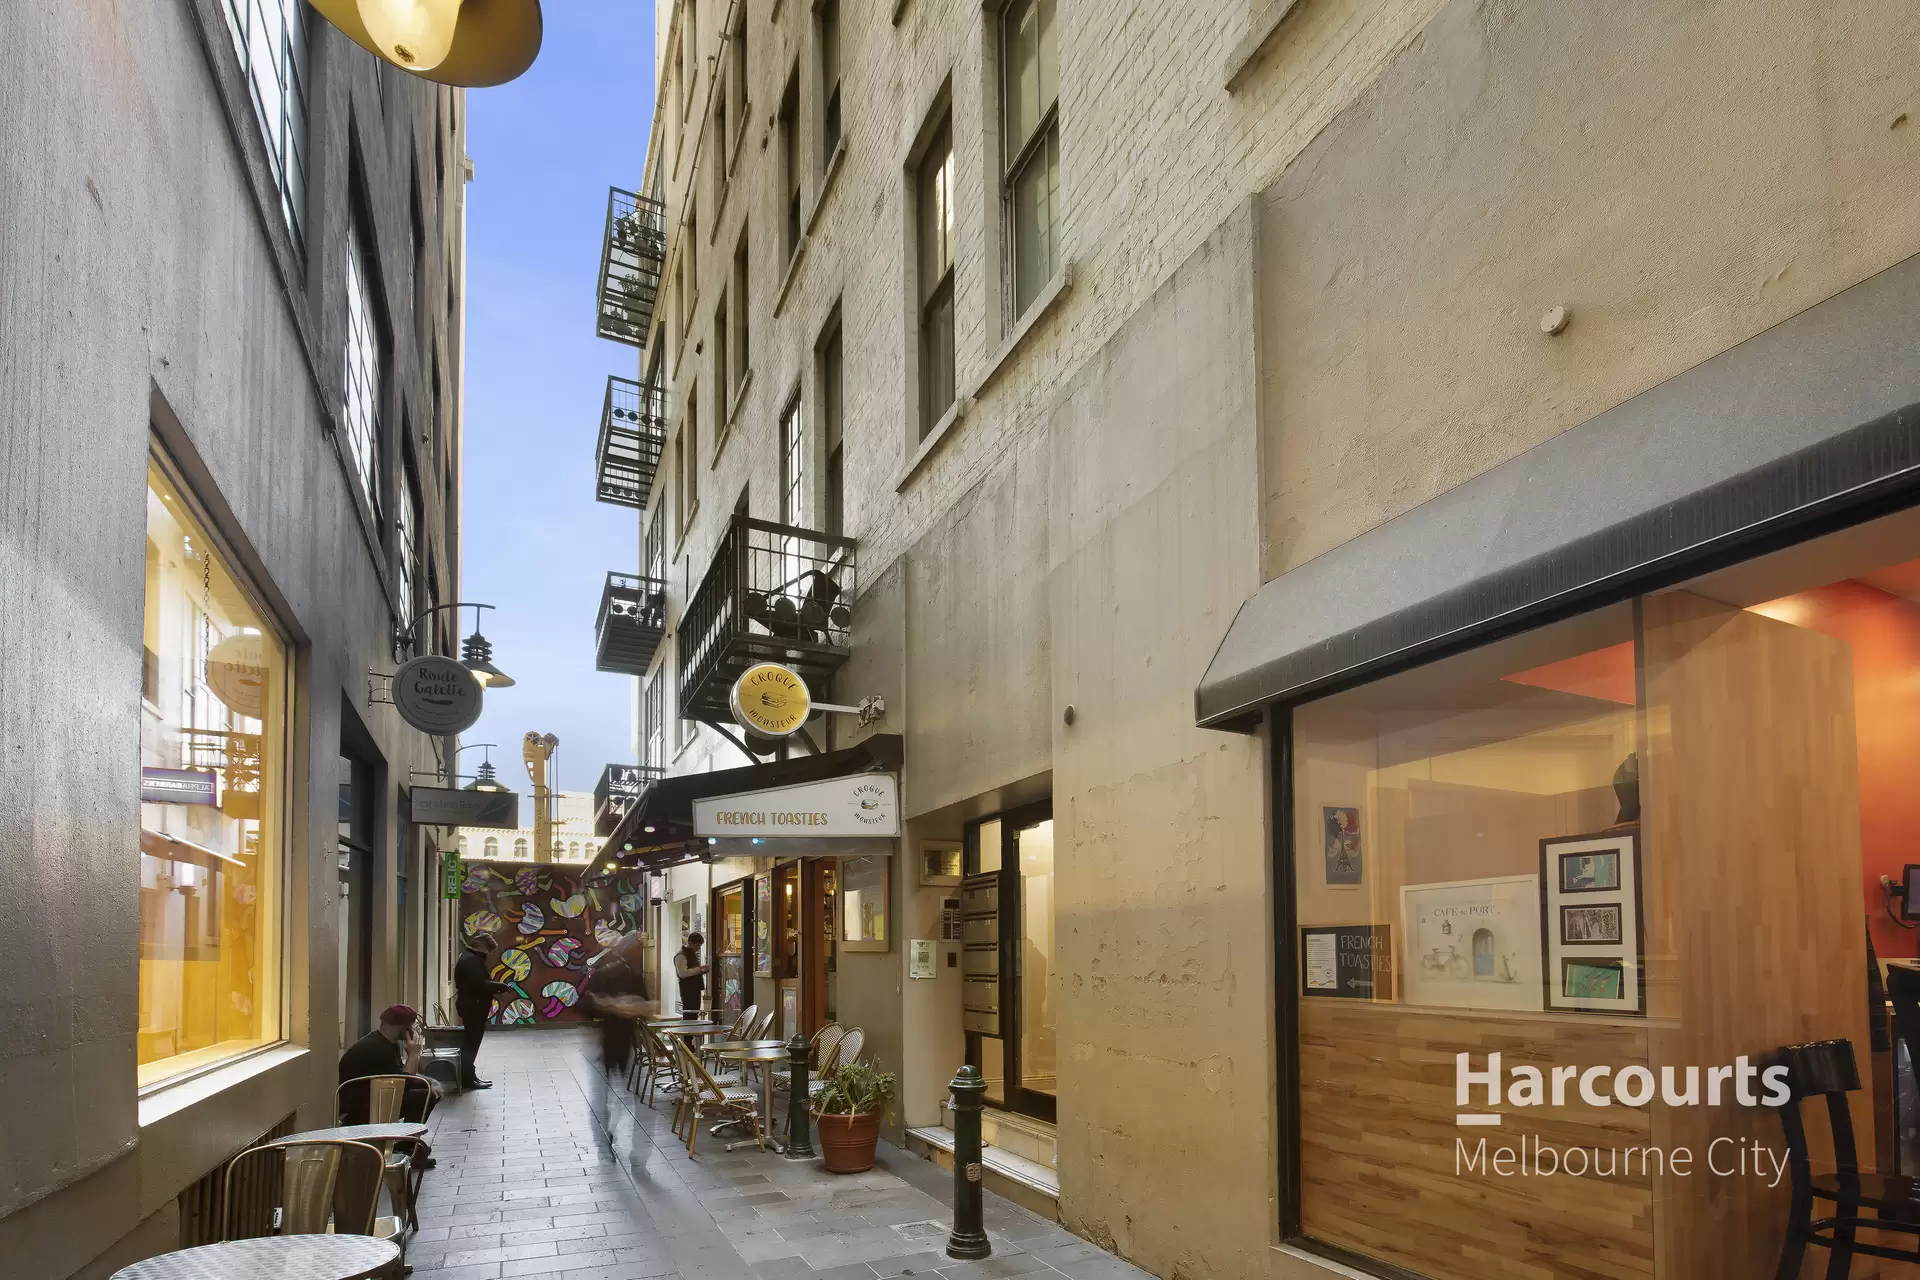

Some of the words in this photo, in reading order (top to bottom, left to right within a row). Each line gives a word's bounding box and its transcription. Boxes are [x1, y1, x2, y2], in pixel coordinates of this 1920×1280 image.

[750, 671, 799, 692] CROQUE
[749, 708, 797, 729] MONSIEUR
[853, 784, 885, 798] CROQUE
[716, 811, 766, 826] FRENCH
[770, 812, 829, 826] TOASTIES
[853, 812, 887, 825] MONSIEUR
[447, 859, 458, 894] RELIC
[1433, 907, 1458, 917] CAFE
[1340, 935, 1383, 950] FRENCH
[1340, 952, 1393, 973] TOASTIES
